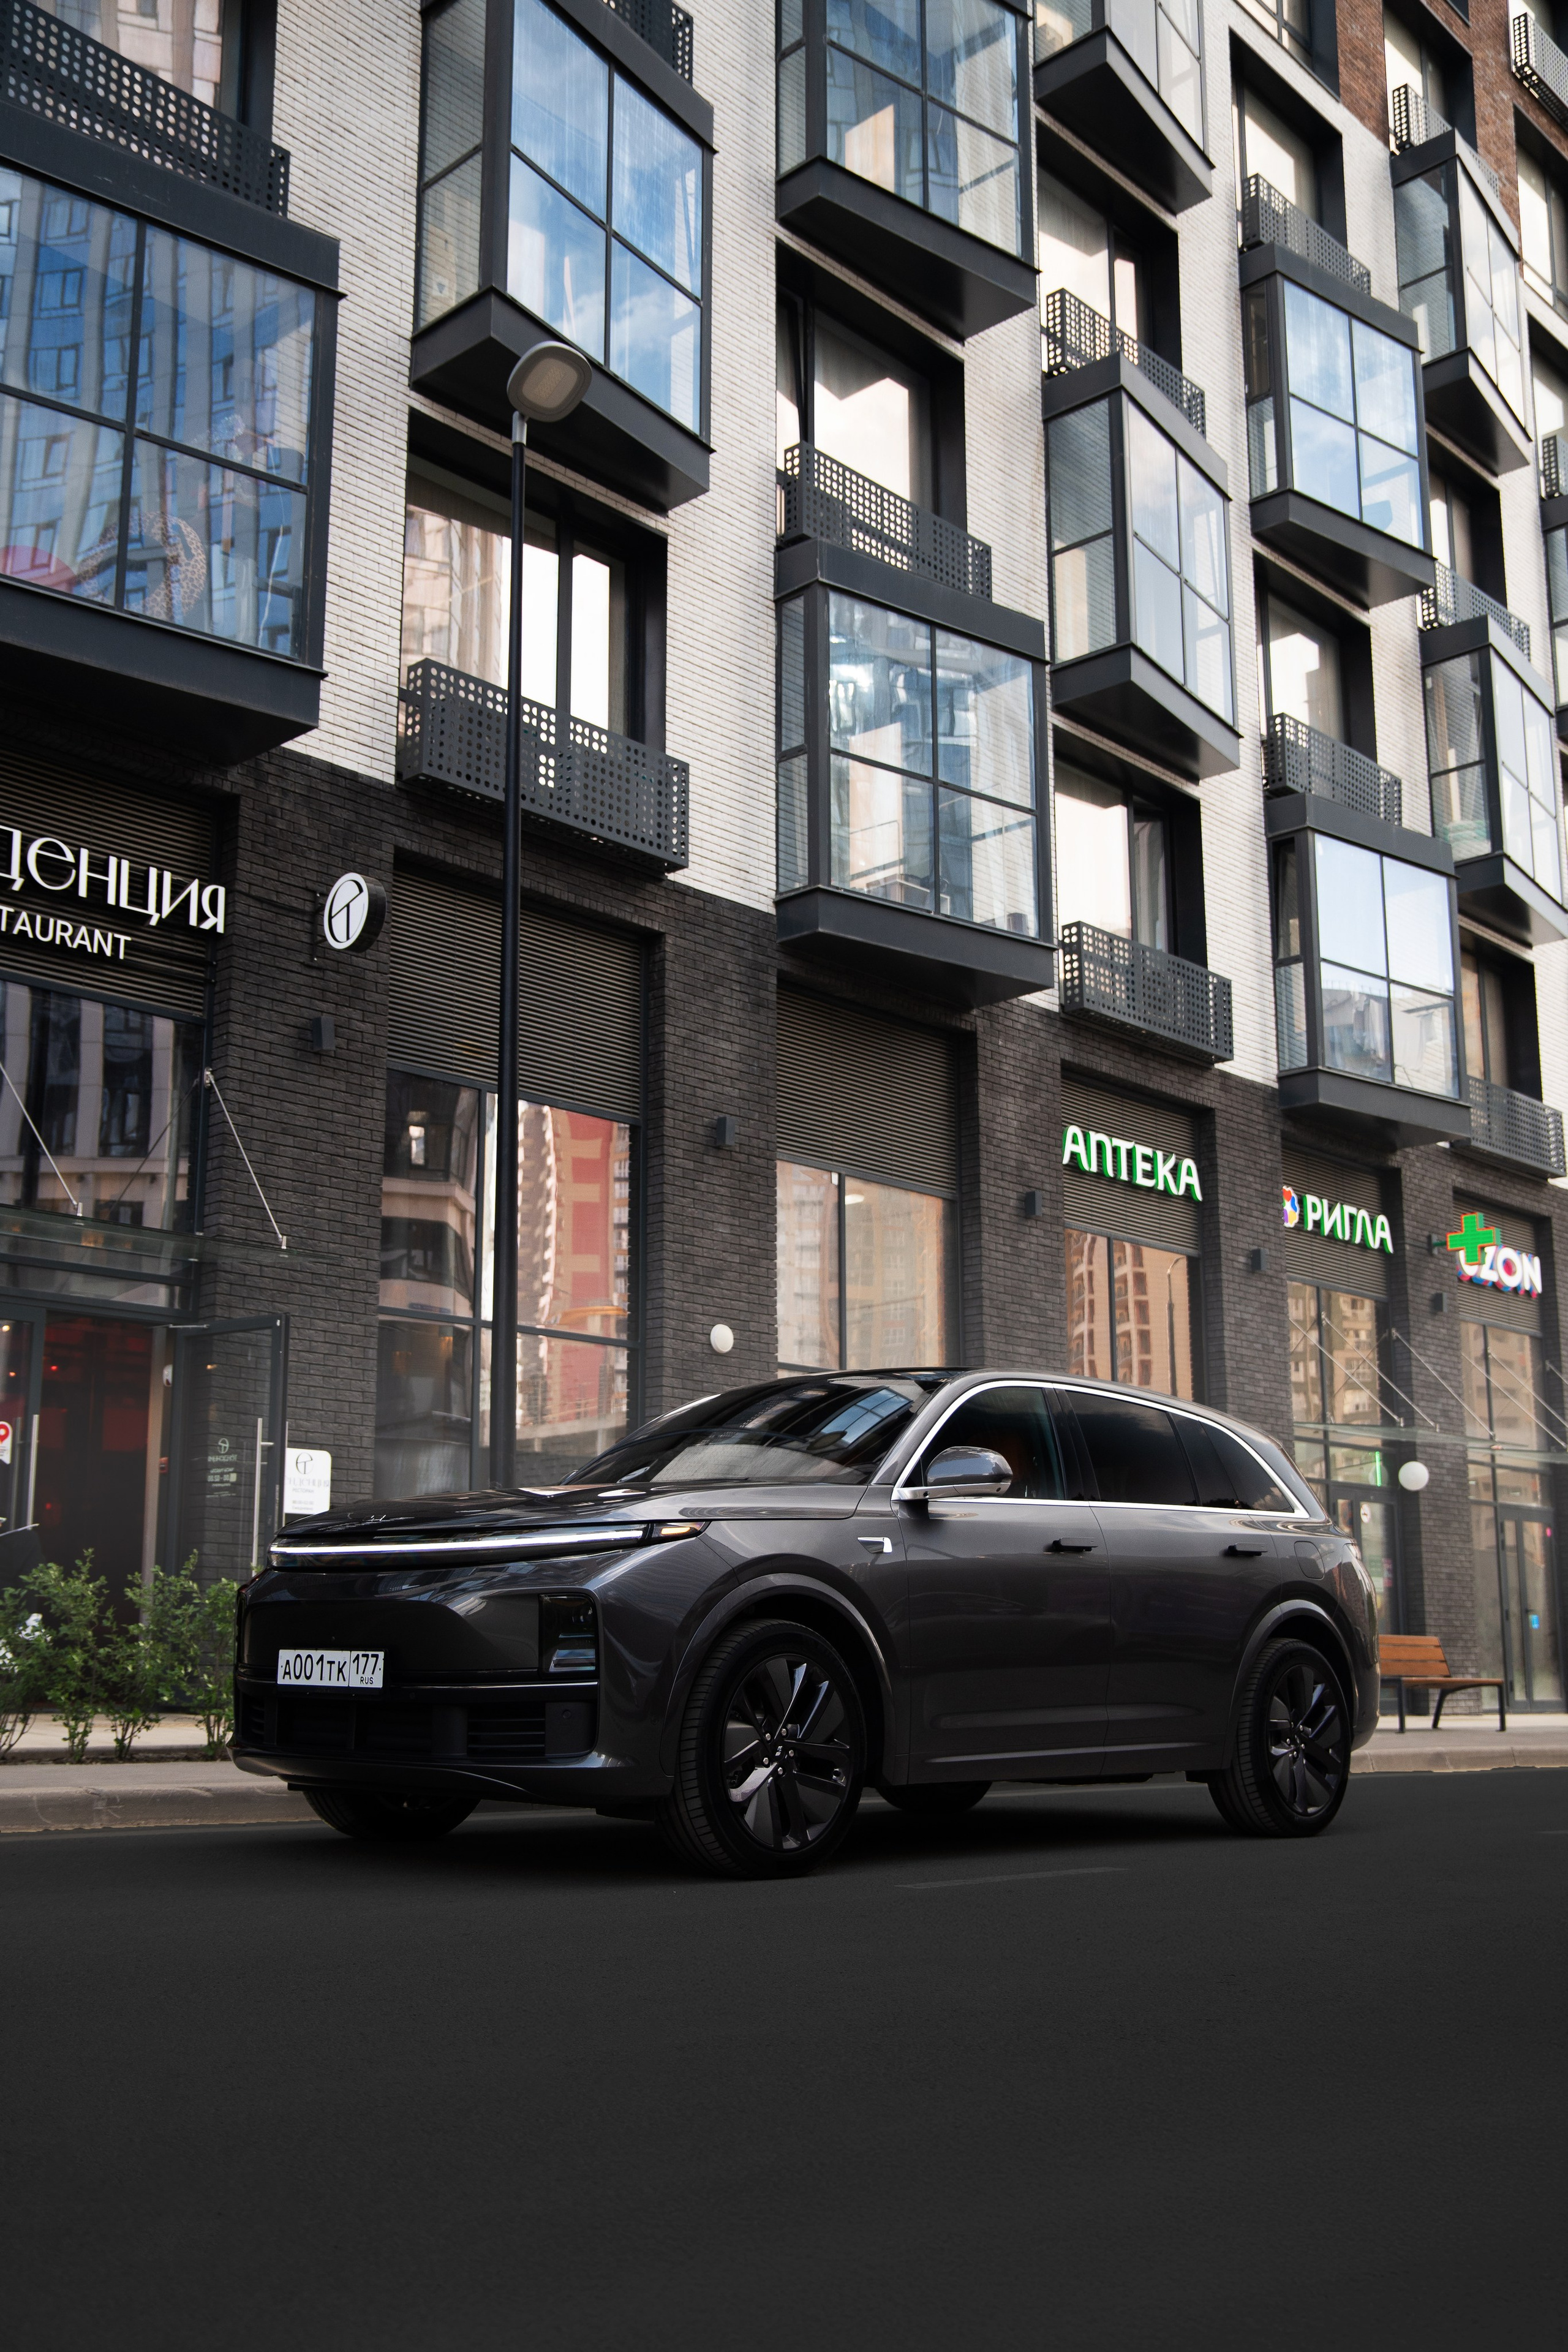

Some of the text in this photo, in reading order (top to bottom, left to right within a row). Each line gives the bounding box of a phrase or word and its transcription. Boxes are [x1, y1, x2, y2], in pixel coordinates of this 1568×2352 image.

[0, 905, 132, 960] TAURANT
[1062, 1125, 1203, 1202] АПТЕКА
[1303, 1194, 1394, 1254] РИГЛА
[352, 1653, 379, 1675] 177
[360, 1676, 374, 1685] RUS
